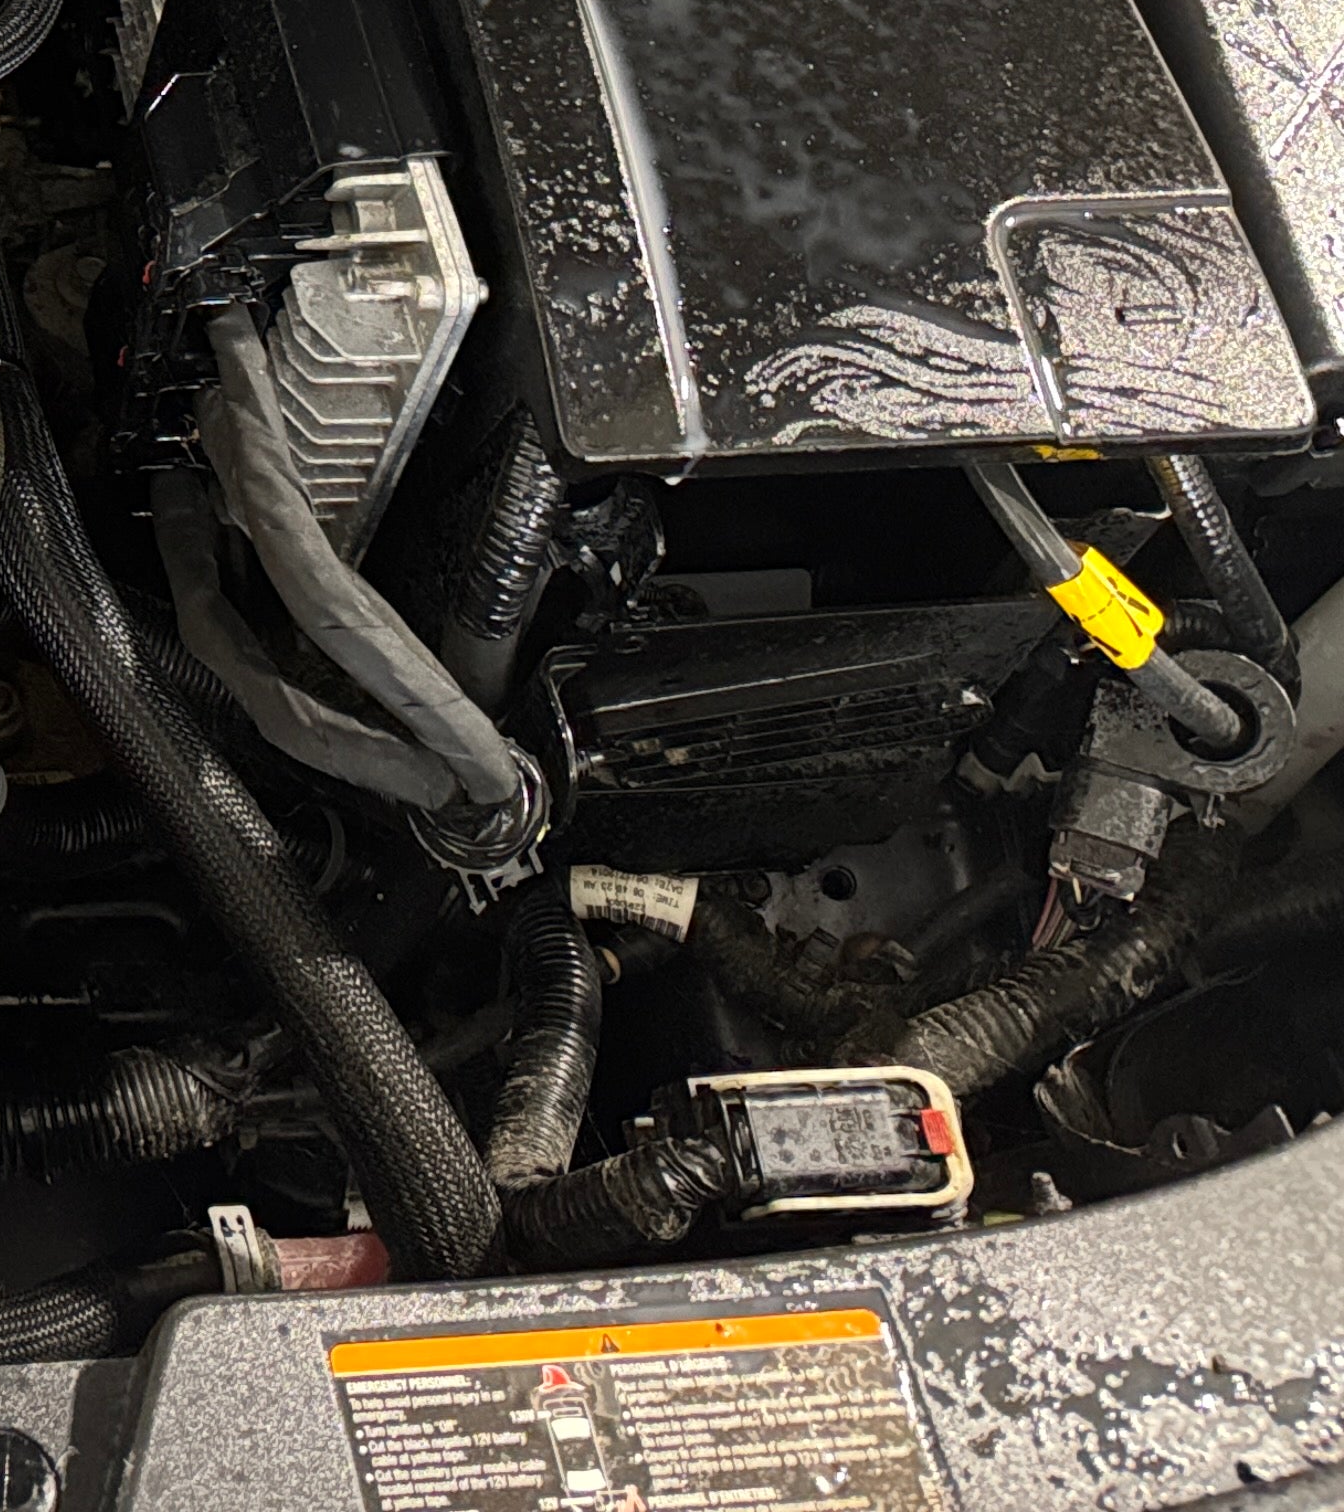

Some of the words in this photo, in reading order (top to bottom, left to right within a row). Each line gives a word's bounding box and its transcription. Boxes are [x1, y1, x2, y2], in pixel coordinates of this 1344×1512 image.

[346, 1378, 407, 1395] EMERGENCY
[349, 1398, 362, 1411] To
[412, 1394, 452, 1408] personal
[364, 1425, 386, 1438] Turn
[368, 1440, 385, 1455] Cut
[404, 1437, 430, 1451] black
[492, 1432, 527, 1447] battery
[374, 1468, 393, 1482] Cut
